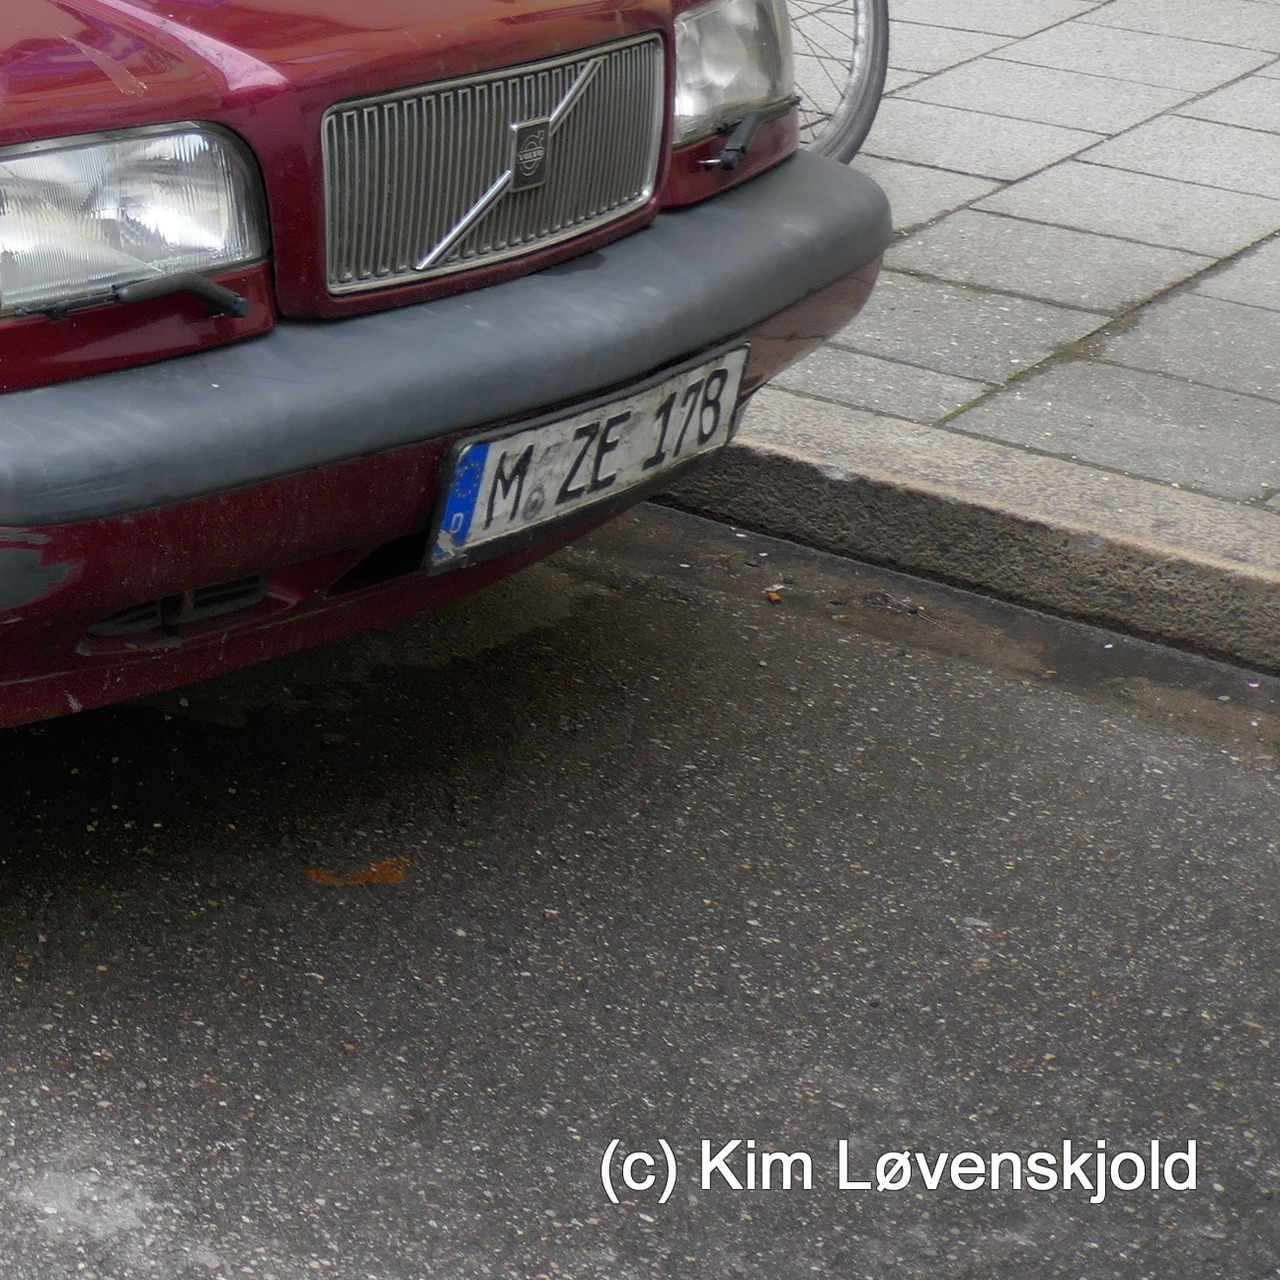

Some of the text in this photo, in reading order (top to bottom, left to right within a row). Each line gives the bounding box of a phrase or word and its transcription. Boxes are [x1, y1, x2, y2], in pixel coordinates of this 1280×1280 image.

[518, 149, 543, 161] VOLVO
[484, 369, 729, 530] M ZE 178
[451, 513, 463, 534] D
